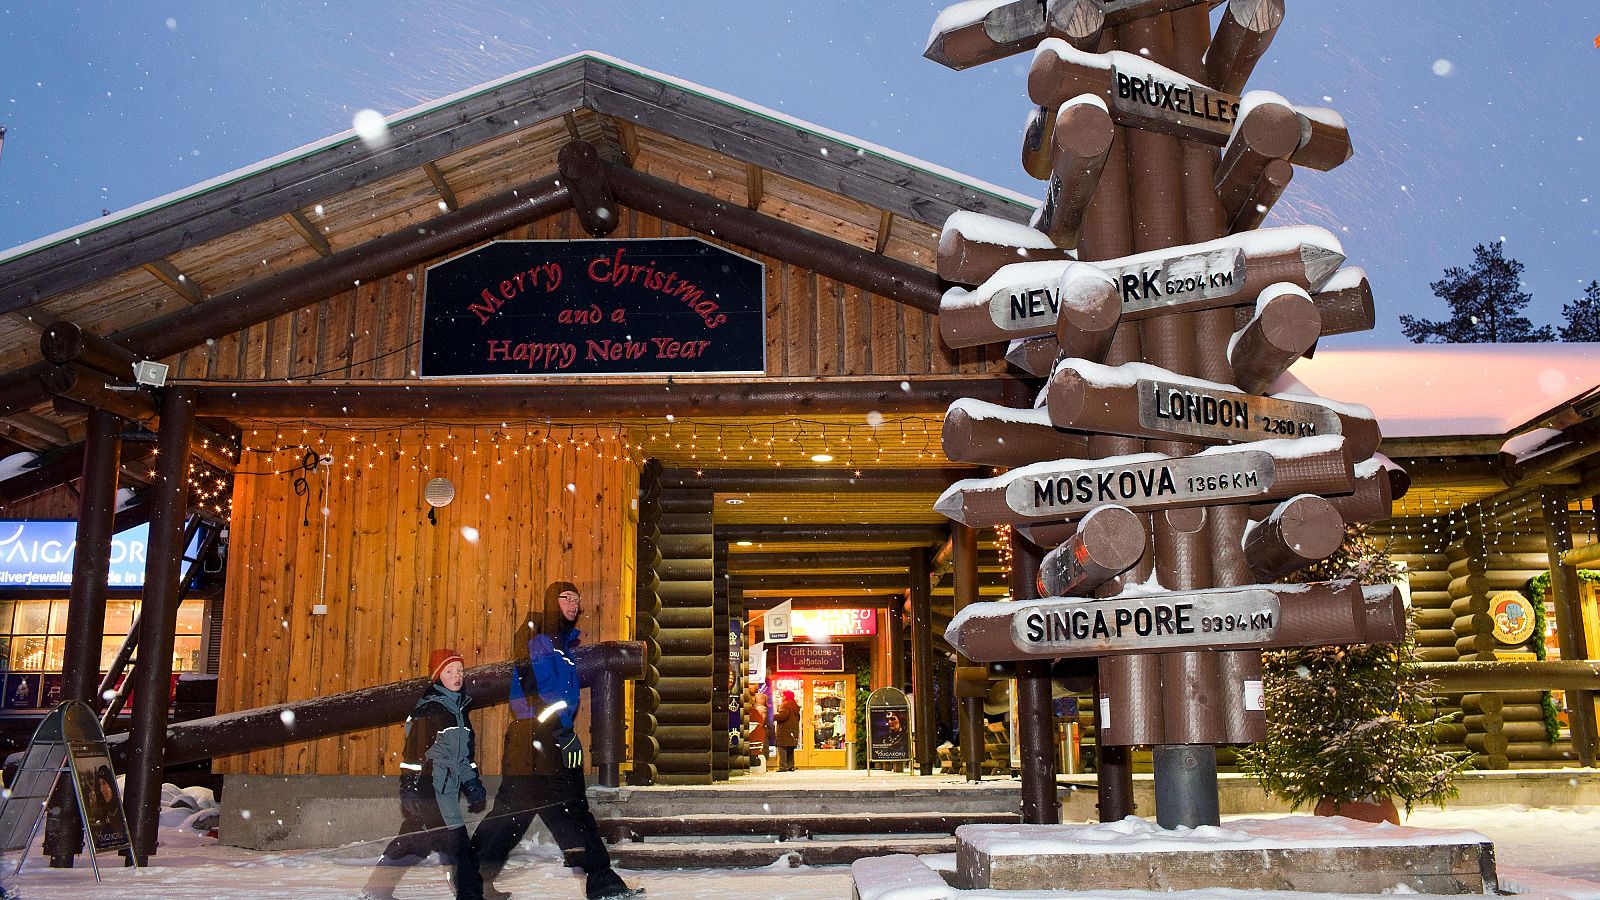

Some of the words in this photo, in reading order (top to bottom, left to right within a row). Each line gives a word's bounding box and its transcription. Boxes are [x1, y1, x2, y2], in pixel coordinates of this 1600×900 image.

[1117, 71, 1240, 124] BRUXELLES
[467, 261, 563, 325] Merry
[587, 247, 727, 329] Christmas
[1165, 274, 1206, 295] 6204
[1209, 271, 1233, 289] KM
[558, 304, 602, 325] and
[611, 307, 626, 324] a
[486, 339, 576, 369] Happy
[584, 339, 647, 361] New
[650, 337, 711, 360] Year
[1154, 383, 1249, 430] LONDON
[1262, 416, 1295, 435] 2260
[1298, 422, 1317, 438] KM
[1034, 466, 1176, 508] MOSKOVA
[1187, 473, 1229, 493] 1366
[1232, 471, 1258, 489] KM
[125, 571, 137, 583] in
[1026, 603, 1195, 642] SINGAPORE
[1201, 614, 1248, 633] 9394
[1250, 609, 1273, 631] KM
[789, 647, 805, 656] Gift
[807, 647, 832, 656] house
[793, 657, 829, 667] Lahjatalo
